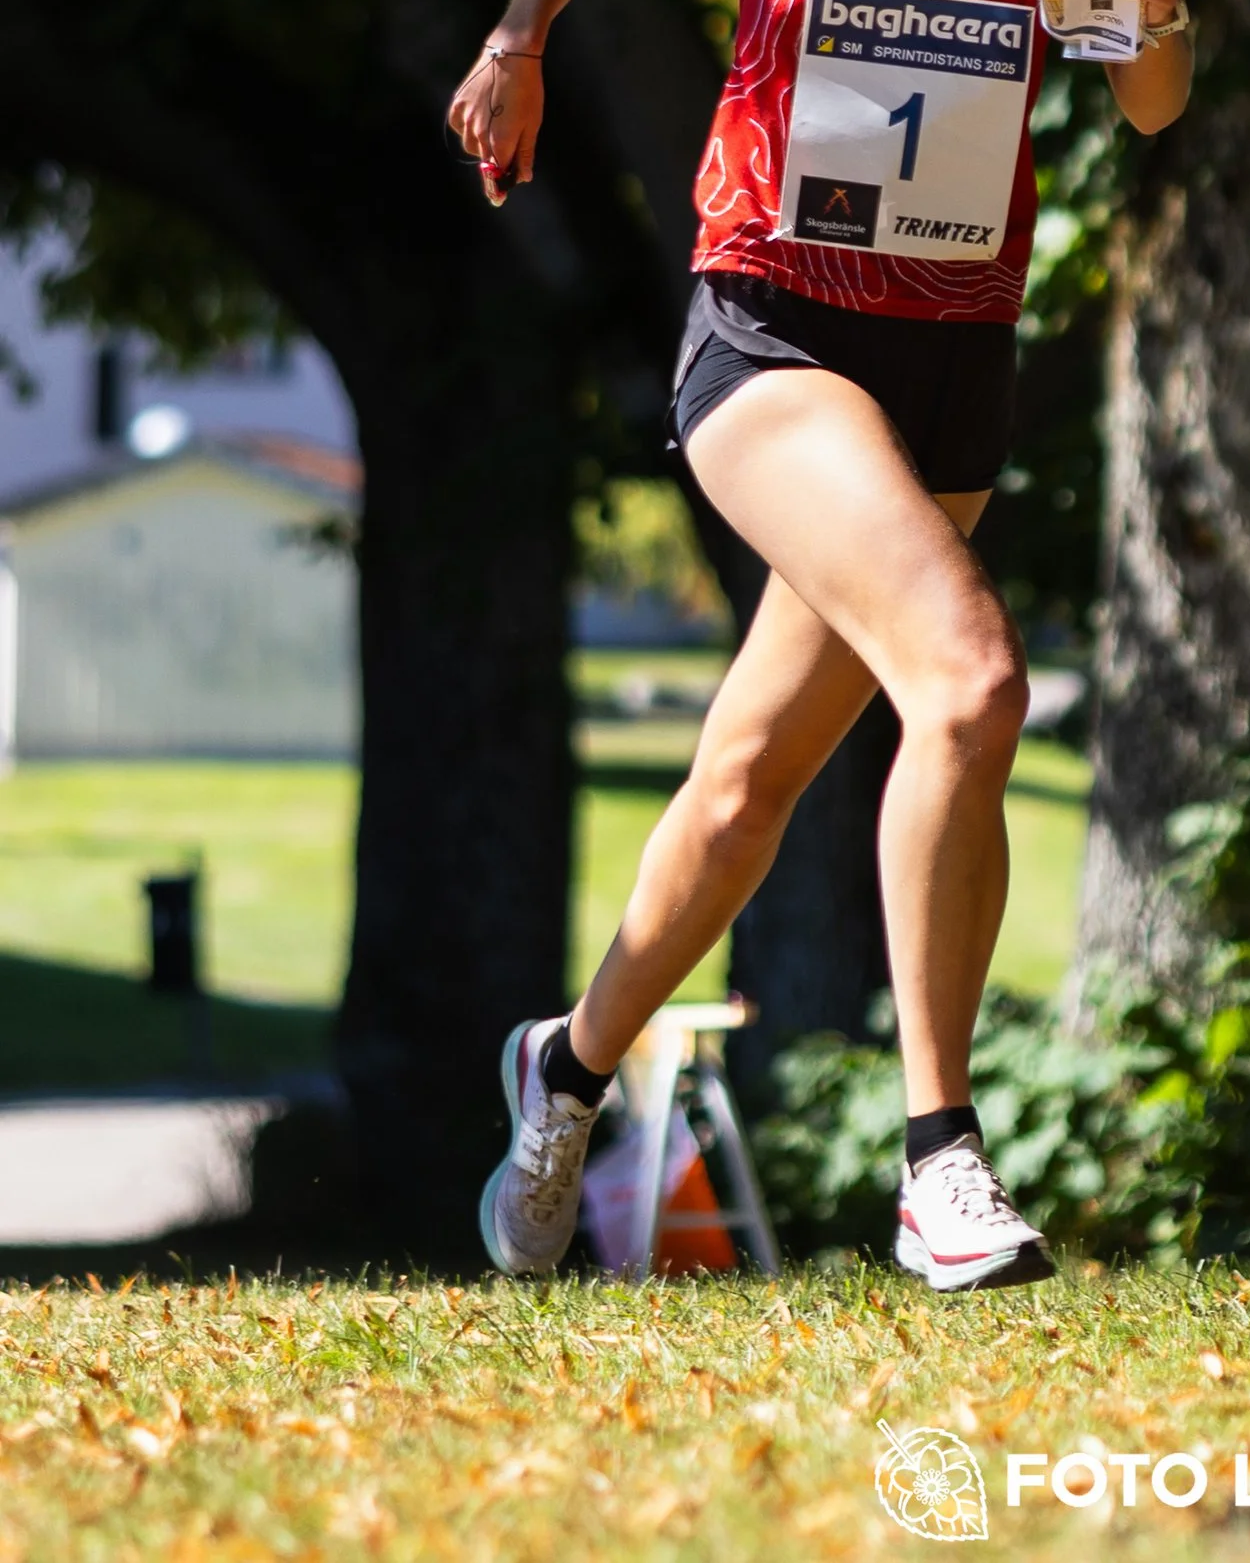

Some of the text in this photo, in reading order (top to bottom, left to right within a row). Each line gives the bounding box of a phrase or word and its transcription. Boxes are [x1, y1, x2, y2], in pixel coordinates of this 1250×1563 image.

[841, 41, 1016, 75] SM SPRINTDISTANS 2025
[888, 92, 926, 182] 1
[805, 217, 866, 234] Skogsbränsle
[893, 215, 996, 246] TRIMTEX
